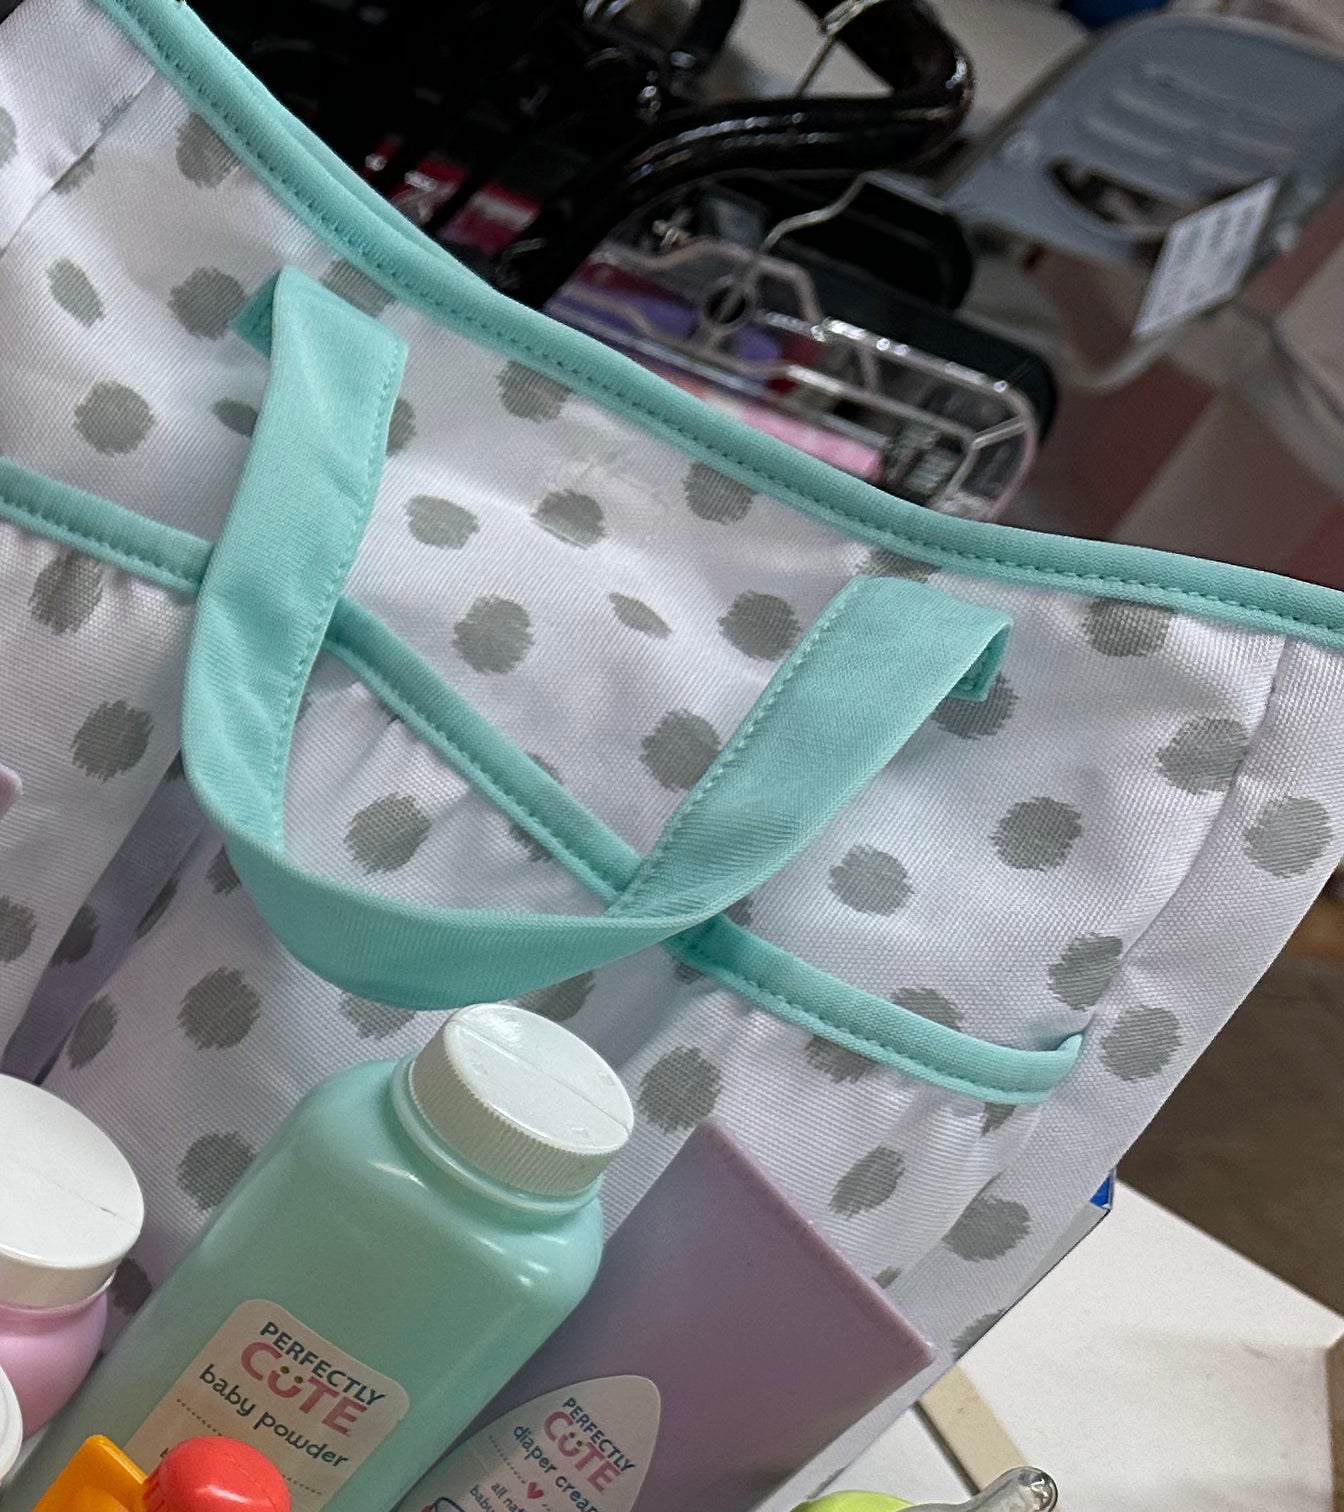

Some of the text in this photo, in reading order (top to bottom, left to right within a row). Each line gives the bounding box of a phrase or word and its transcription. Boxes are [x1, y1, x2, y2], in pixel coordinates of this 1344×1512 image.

[260, 1321, 386, 1406] PERFECTLY
[199, 1363, 349, 1468] baby powder
[513, 1425, 557, 1474] diaper
[562, 1396, 637, 1472] PERFECTLY
[490, 1481, 506, 1500] all
